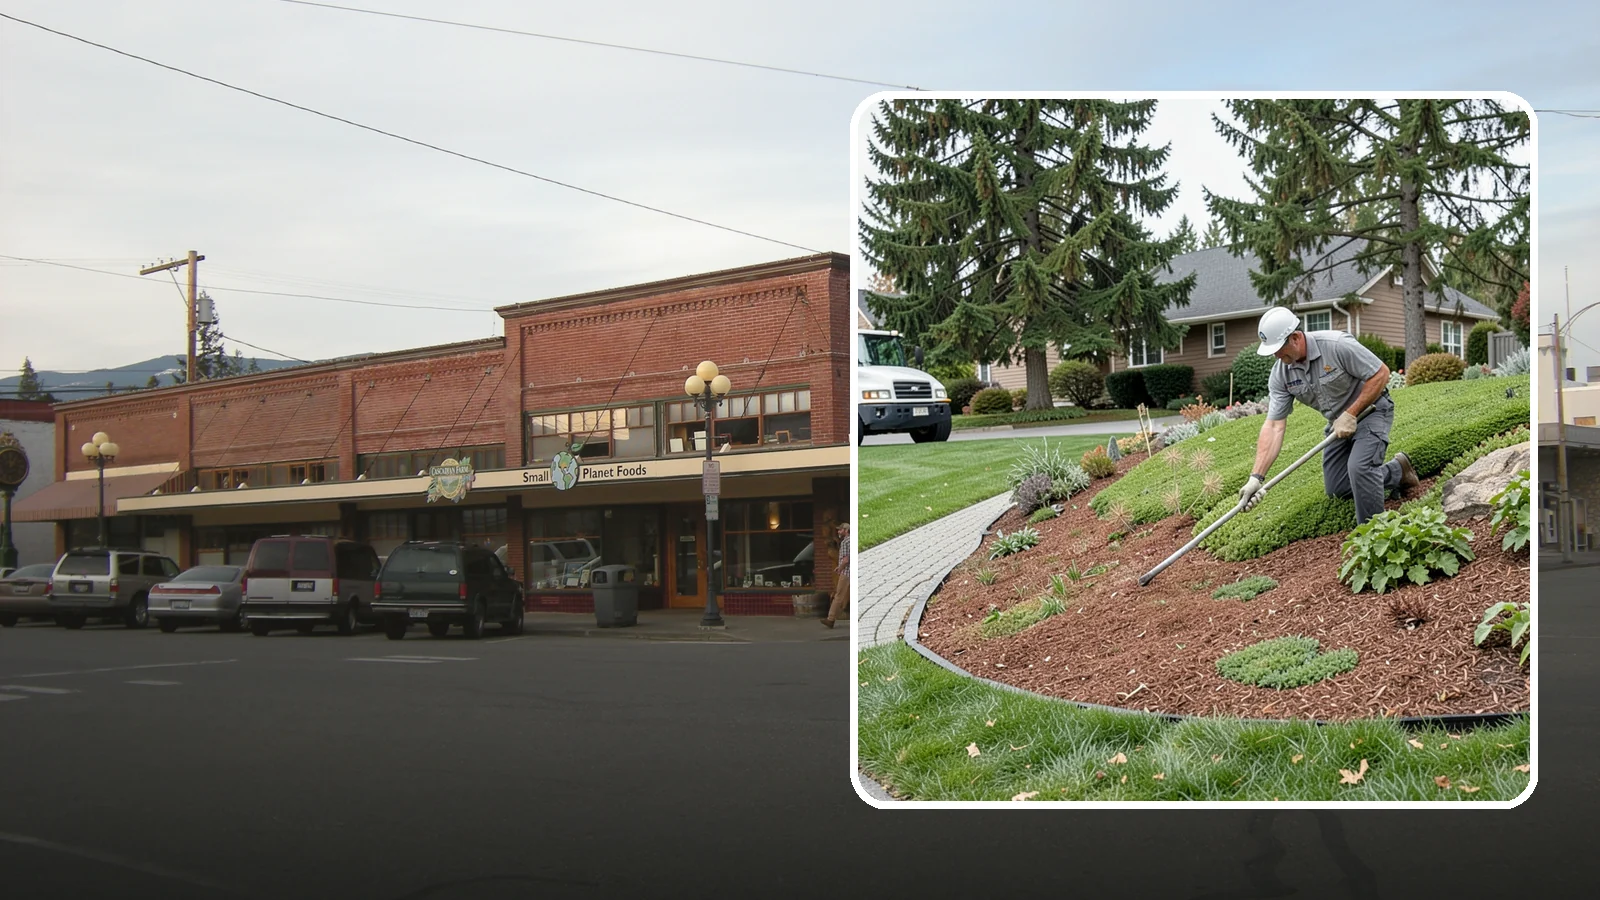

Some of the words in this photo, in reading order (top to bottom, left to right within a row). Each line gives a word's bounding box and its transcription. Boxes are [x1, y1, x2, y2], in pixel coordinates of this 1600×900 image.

[523, 471, 549, 483] Small
[582, 467, 614, 479] Planet
[616, 464, 647, 477] Foods
